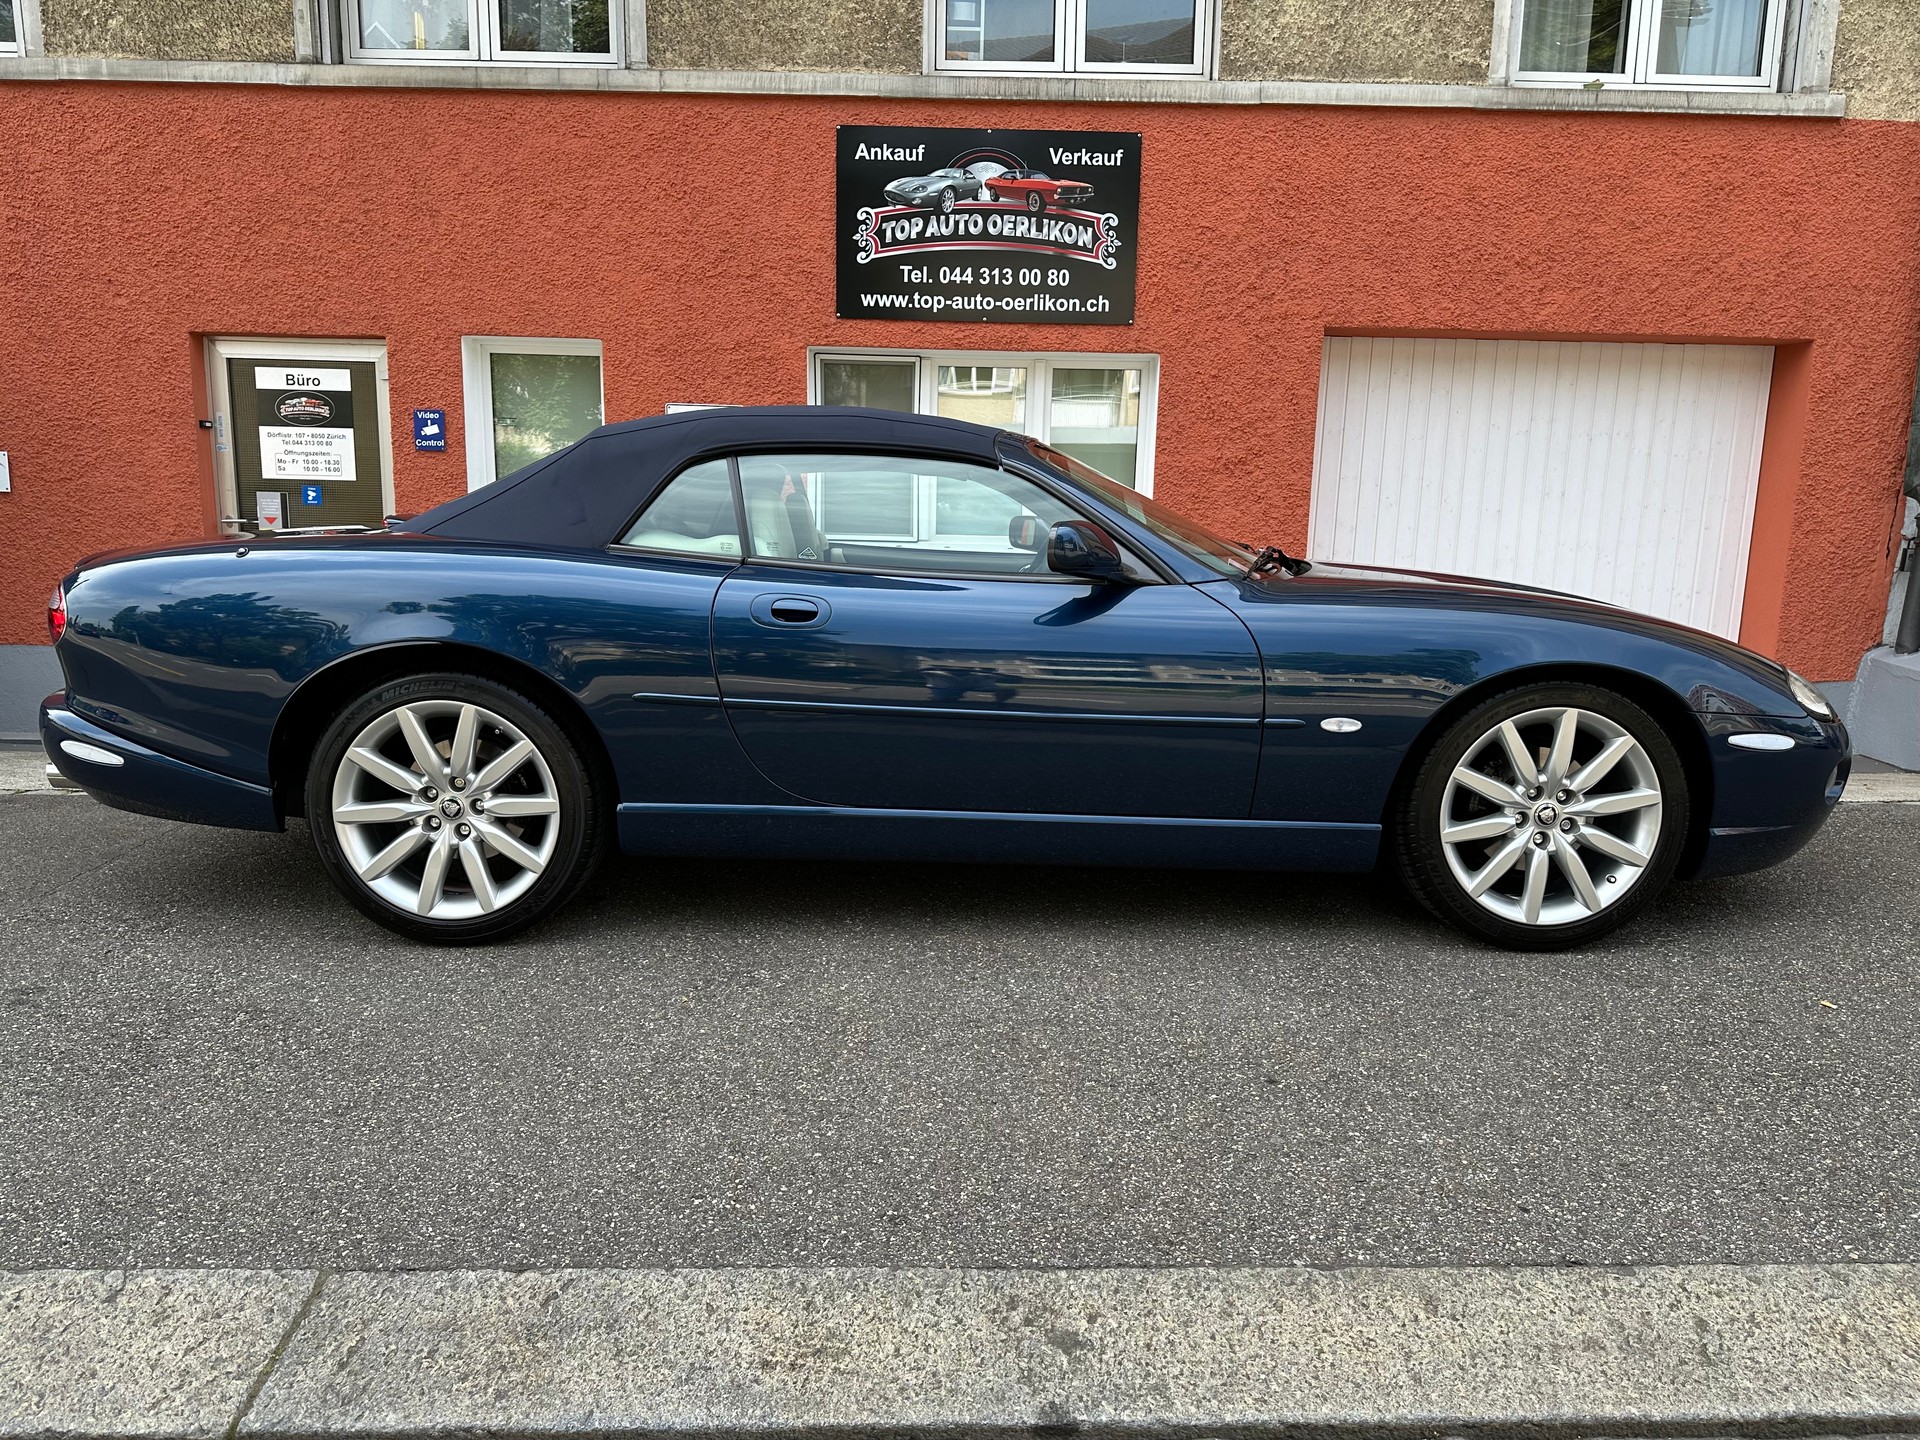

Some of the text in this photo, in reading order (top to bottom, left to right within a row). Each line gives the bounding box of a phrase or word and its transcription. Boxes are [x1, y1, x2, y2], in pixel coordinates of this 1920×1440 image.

[855, 143, 925, 162] Ankauf
[1049, 147, 1124, 166] Verkauf
[882, 214, 1094, 249] TOP AUTO OERLIKON
[900, 266, 1070, 286] Tel. 044 313 00 80
[861, 291, 1109, 316] www.top-auto-oerlikon.ch
[286, 374, 320, 386] Büro
[417, 411, 439, 419] Video
[416, 439, 444, 447] Control
[381, 680, 456, 700] MICHELIN
